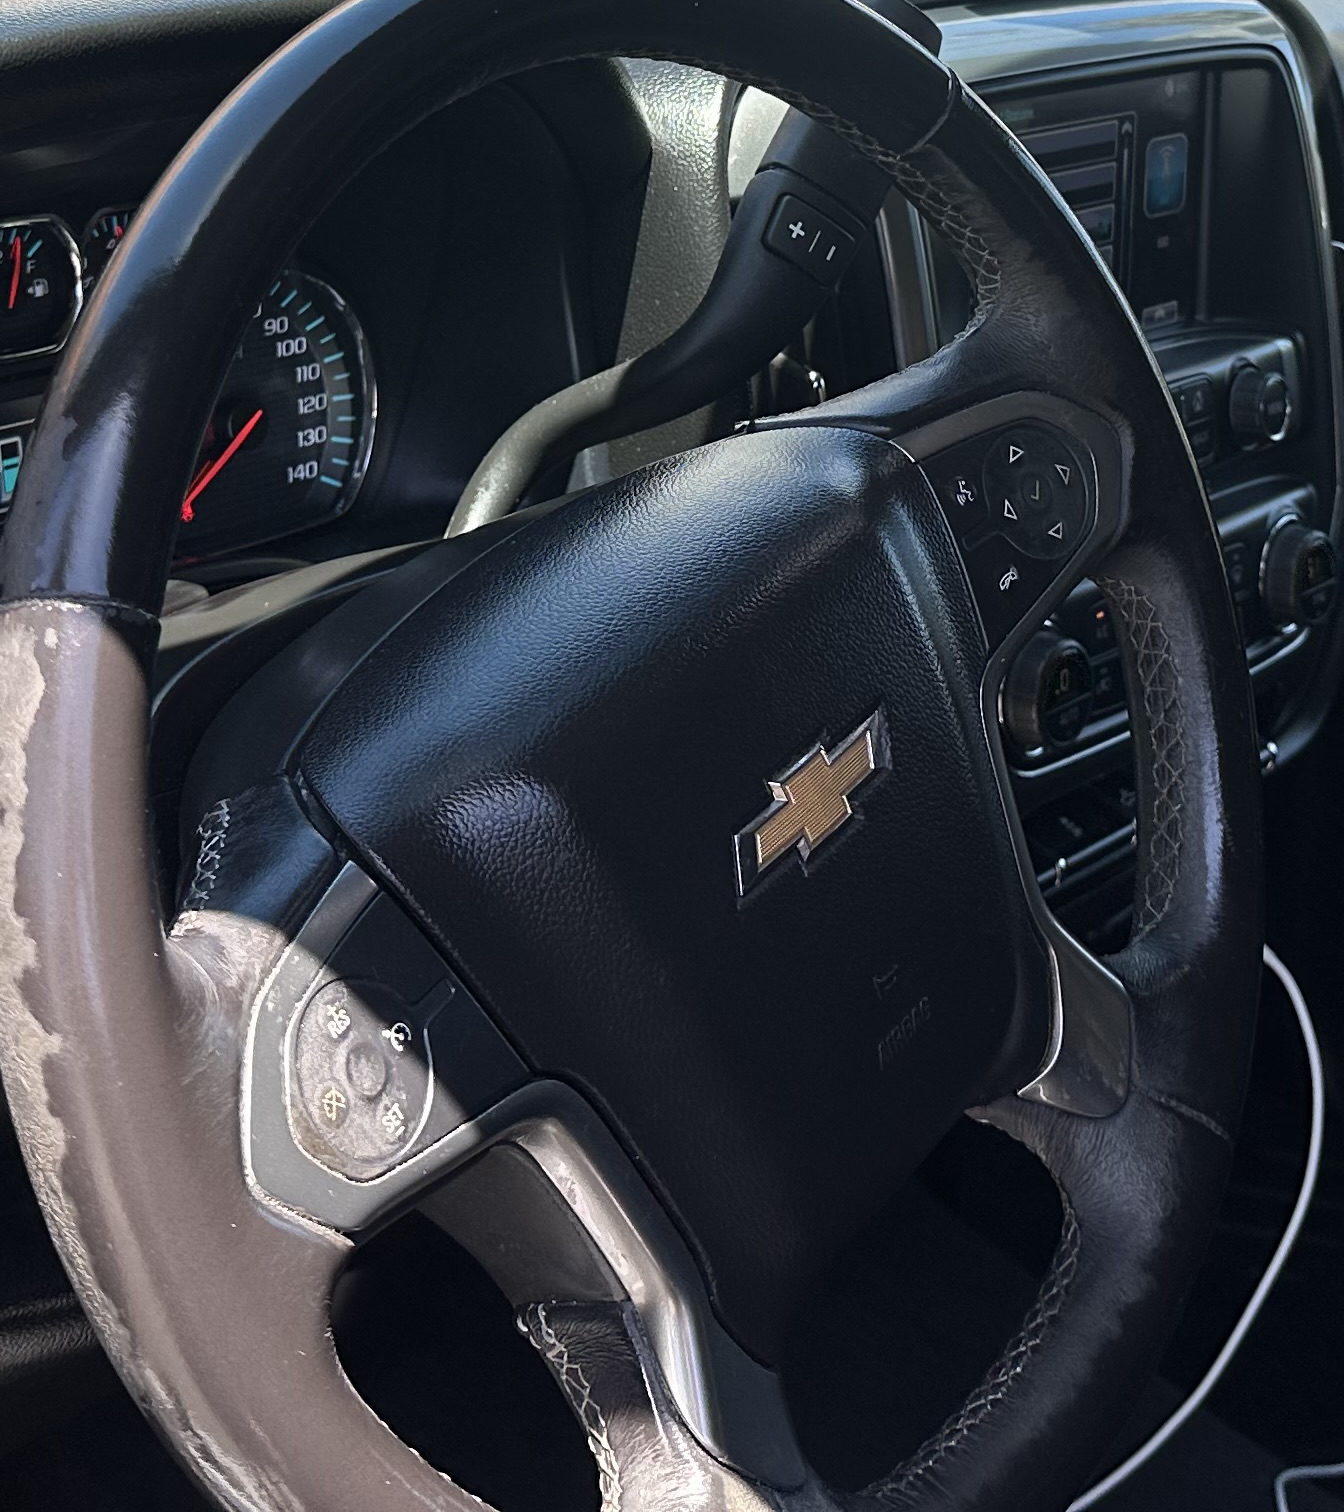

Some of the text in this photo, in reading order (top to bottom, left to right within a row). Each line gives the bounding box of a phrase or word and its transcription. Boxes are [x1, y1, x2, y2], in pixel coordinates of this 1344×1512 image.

[263, 316, 289, 336] 90
[275, 336, 307, 358] 100
[295, 363, 321, 383] 110
[297, 393, 327, 415] 120
[296, 425, 327, 447] 130
[287, 460, 319, 484] 140
[327, 1010, 352, 1040] RES
[381, 1102, 406, 1134] SET
